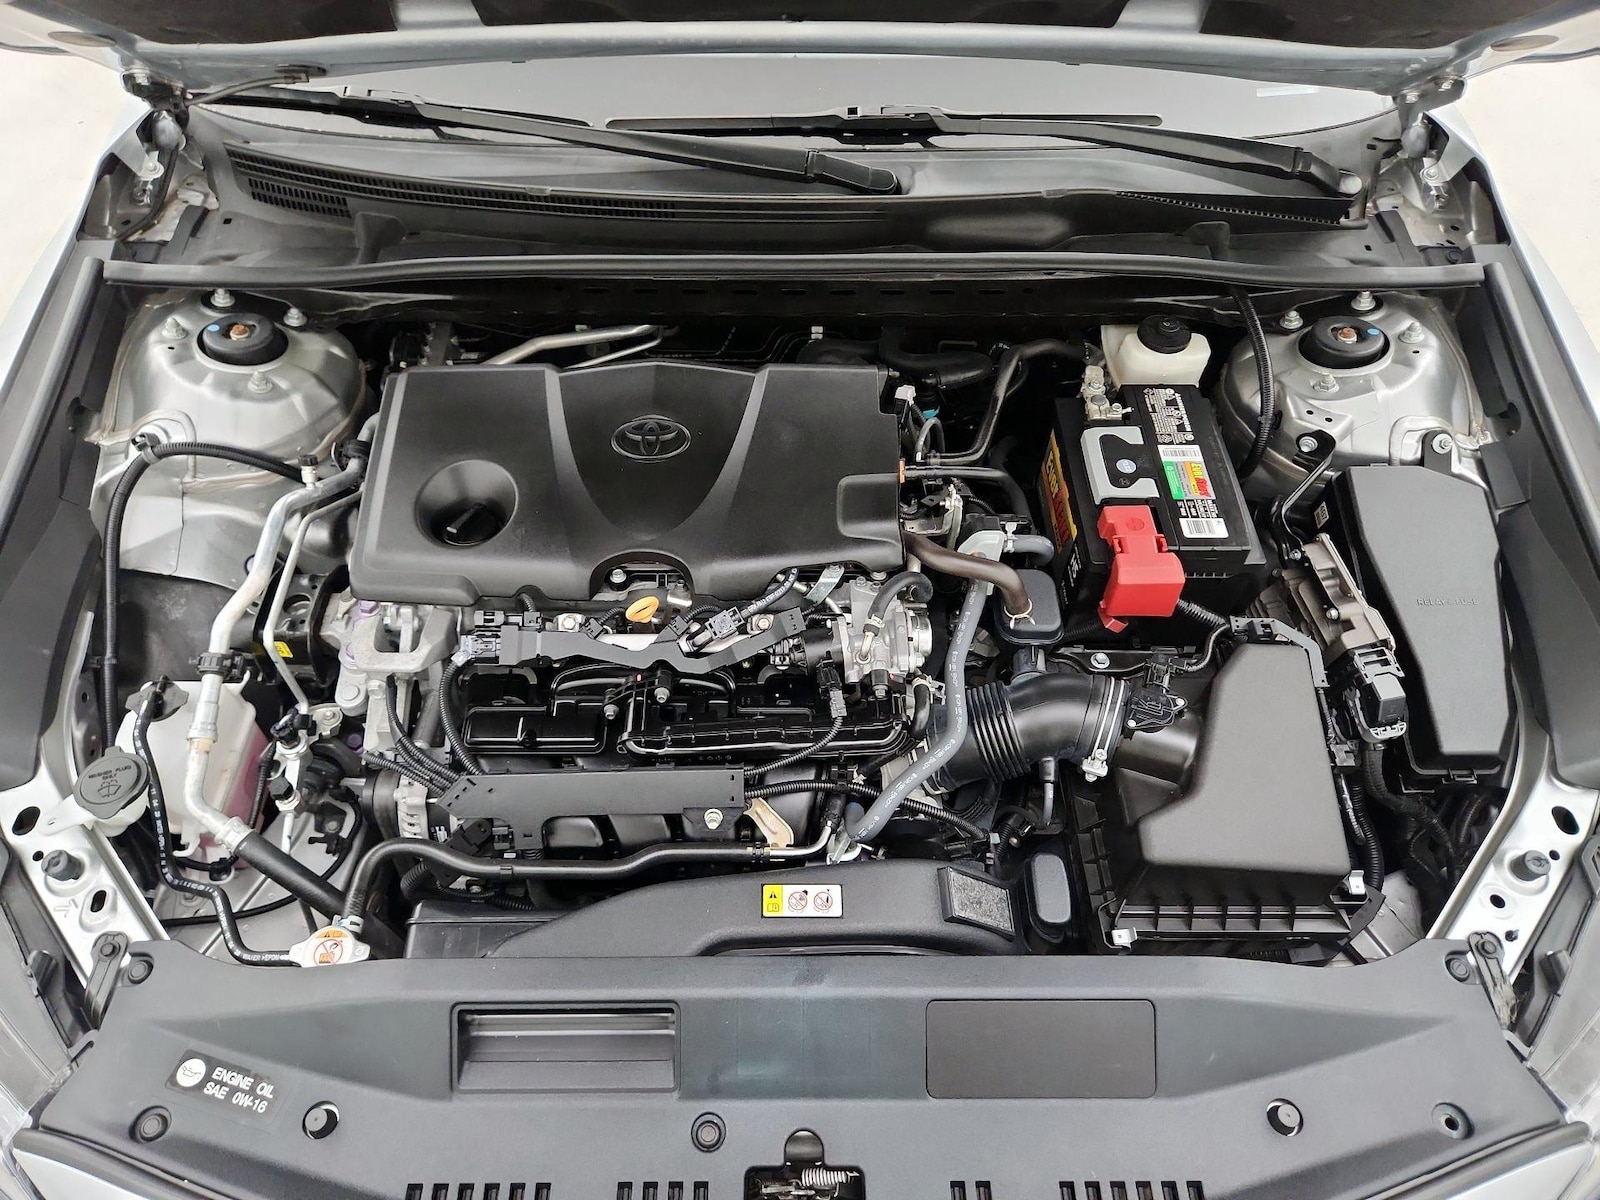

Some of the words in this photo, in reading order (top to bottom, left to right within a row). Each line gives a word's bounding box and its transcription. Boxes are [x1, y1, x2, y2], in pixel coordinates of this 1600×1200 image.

[1416, 597, 1445, 607] RELAY
[1455, 597, 1479, 606] FUSE
[203, 1081, 230, 1100] SAE
[231, 1091, 268, 1114] 0W-16
[211, 1066, 255, 1091] ENGINE
[255, 1082, 275, 1099] OIL
